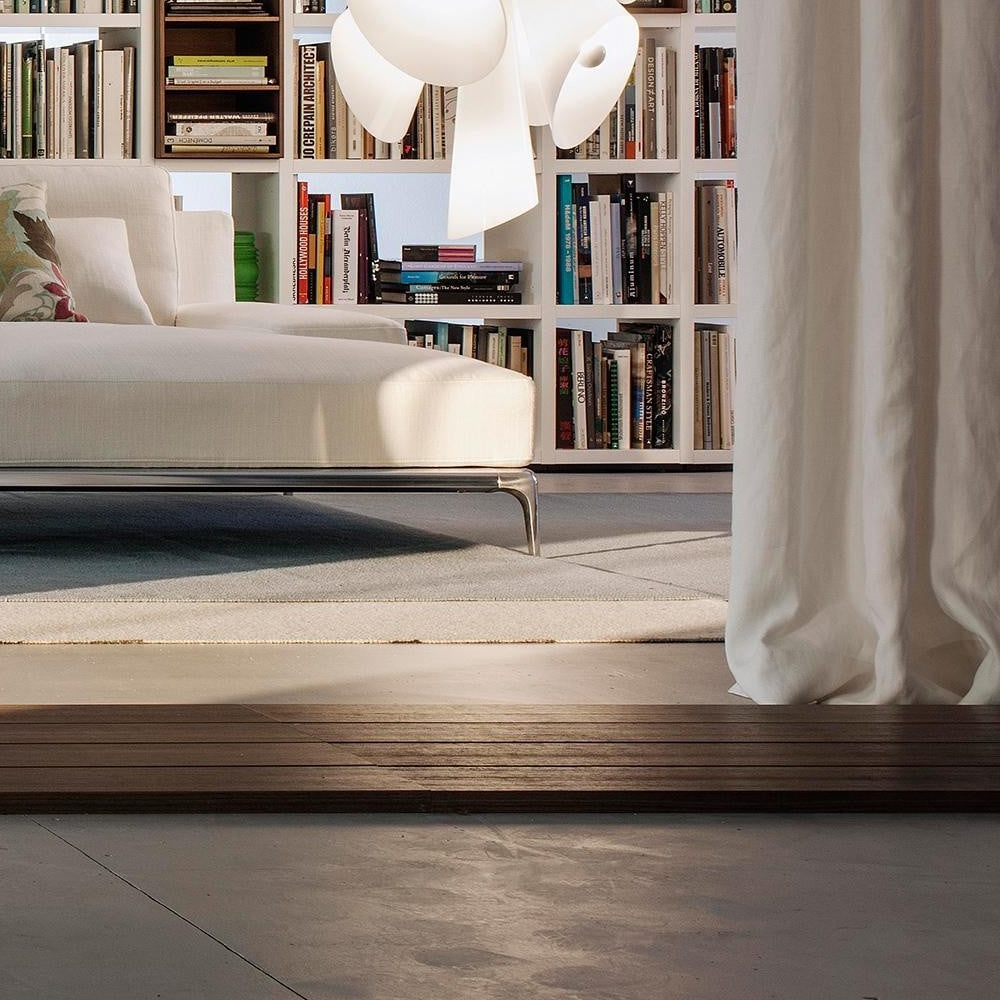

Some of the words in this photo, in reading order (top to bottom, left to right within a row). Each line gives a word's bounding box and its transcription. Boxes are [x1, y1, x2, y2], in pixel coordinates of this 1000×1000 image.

[302, 104, 314, 146] CREPAIN
[299, 207, 308, 234] HOUSES
[342, 226, 350, 246] Berlin
[299, 237, 308, 279] HOLLYWOOD
[342, 249, 350, 293] Alexanderplatz
[715, 228, 724, 278] AUTOMOBILE
[576, 372, 584, 404] BERLINO
[645, 353, 653, 400] CRAFTSMAN
[645, 403, 653, 431] STYLE
